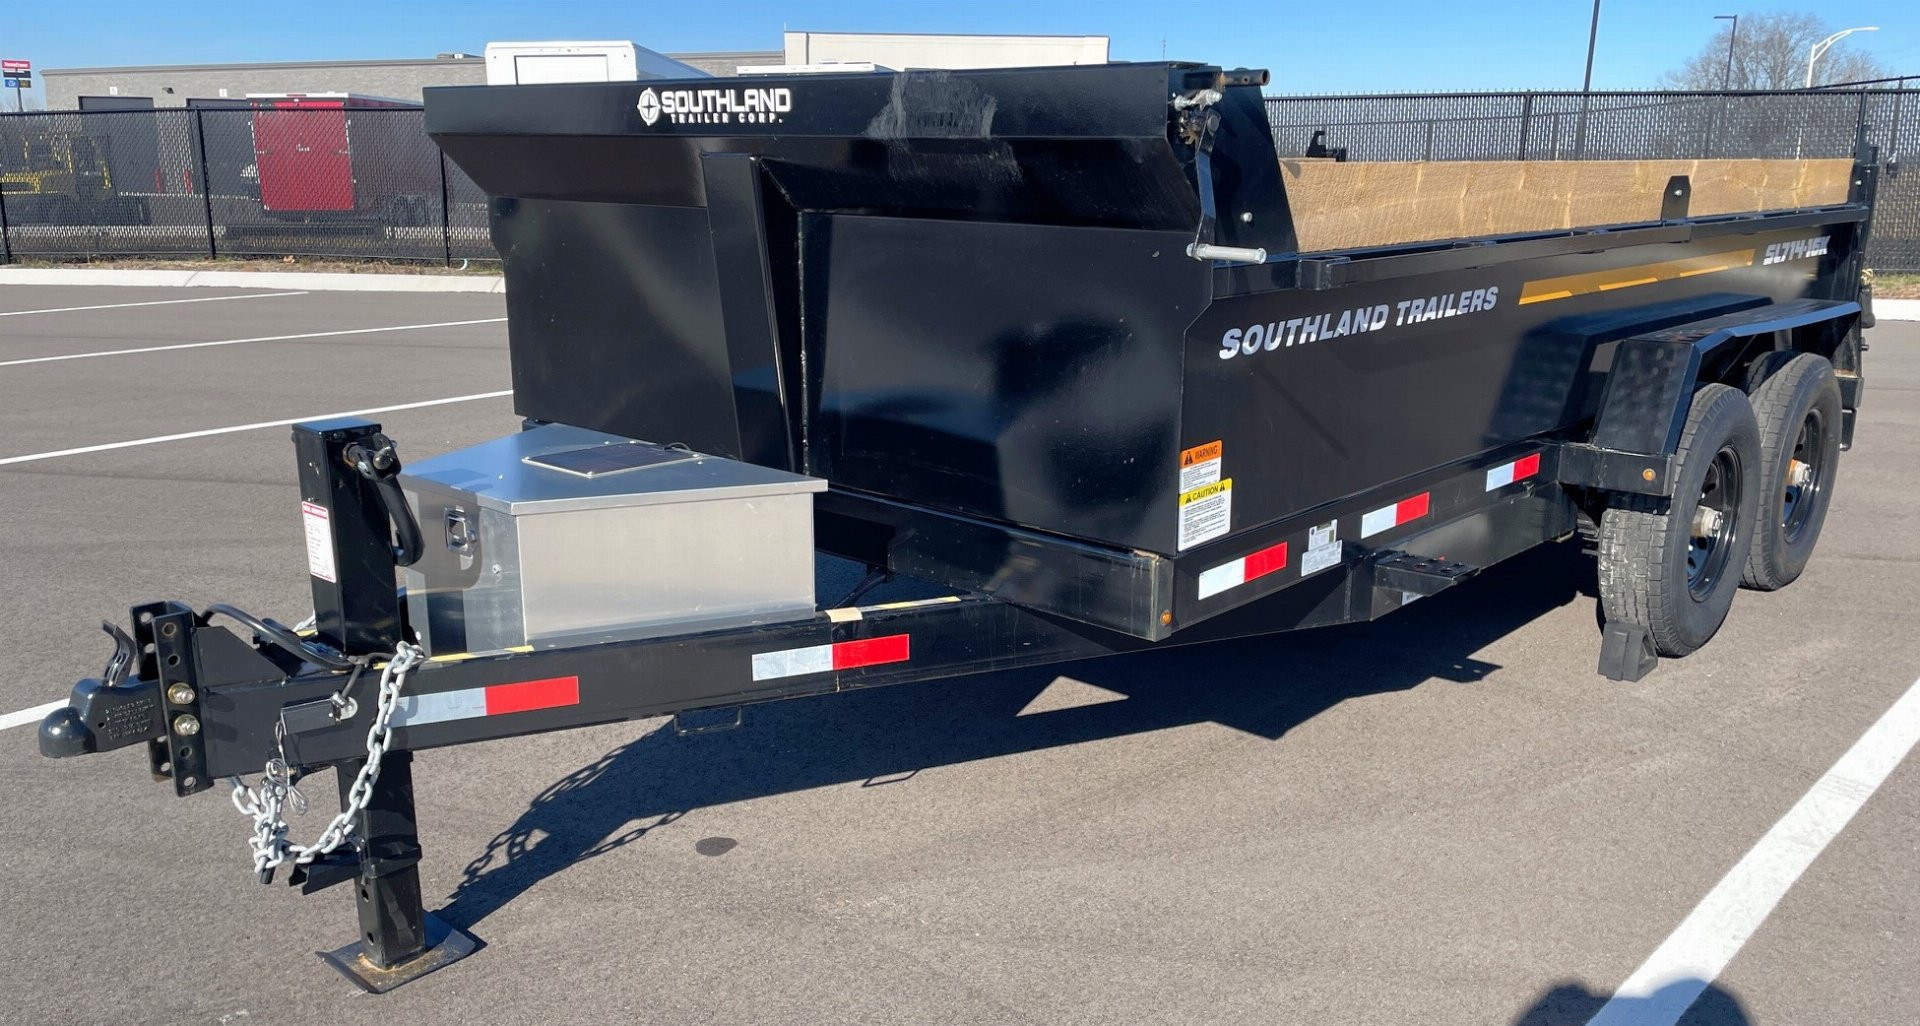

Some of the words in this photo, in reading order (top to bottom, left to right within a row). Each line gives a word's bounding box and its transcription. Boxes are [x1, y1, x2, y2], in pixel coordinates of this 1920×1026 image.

[661, 88, 791, 113] SOUTHLAND
[670, 113, 730, 124] TRAILER
[738, 112, 784, 124] CORP.
[1218, 304, 1390, 360] SOUTHLAND
[1395, 286, 1499, 327] TRAILERS
[1194, 444, 1218, 460] WARNING
[1192, 484, 1219, 501] CAUTION
